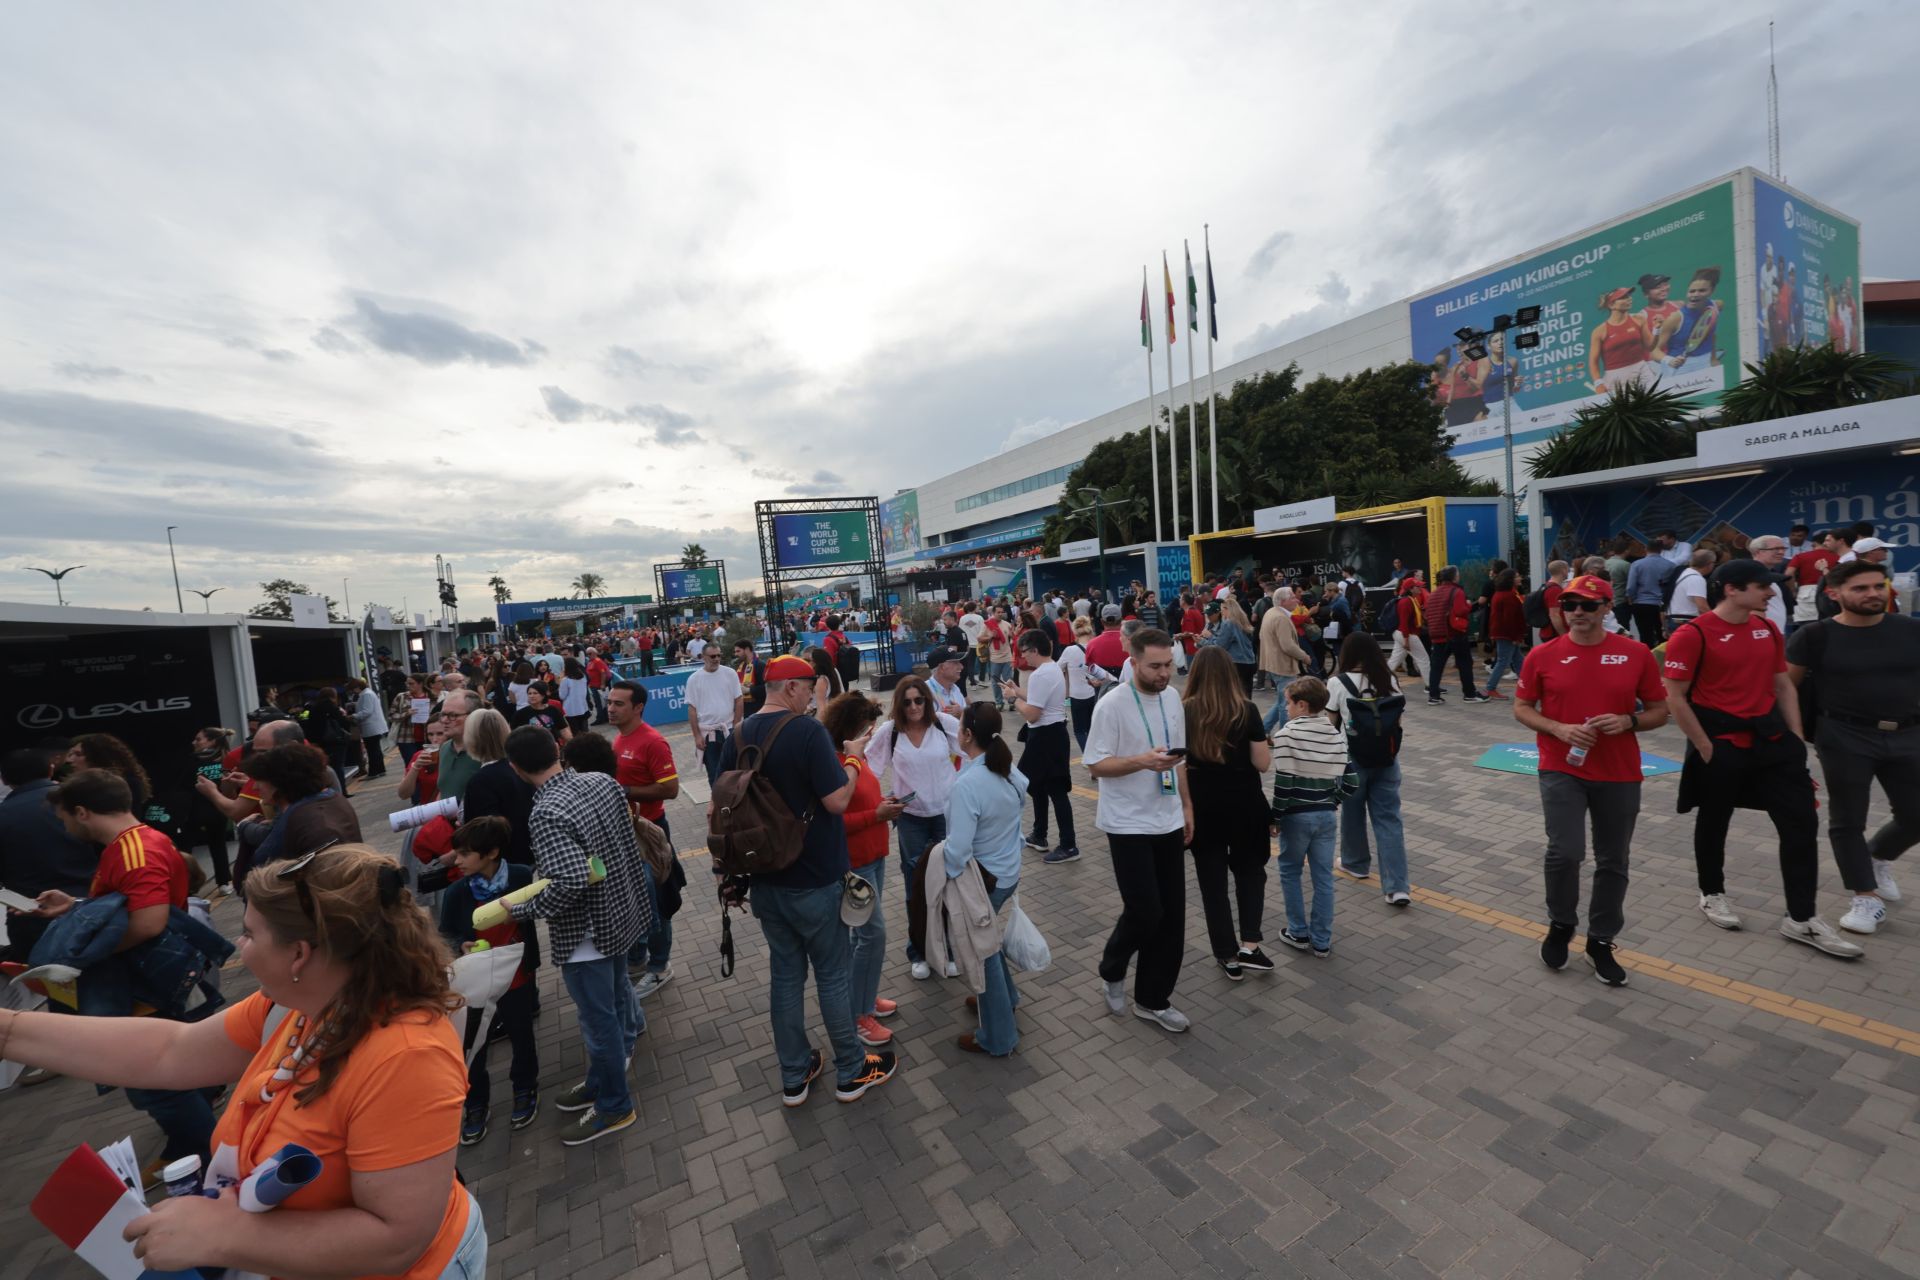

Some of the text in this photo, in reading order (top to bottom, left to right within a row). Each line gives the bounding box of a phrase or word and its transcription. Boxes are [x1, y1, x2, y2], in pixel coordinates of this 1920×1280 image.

[1819, 223, 1837, 241] CUP
[1435, 292, 1479, 317] BILLIE
[1480, 276, 1523, 302] JEAN
[1526, 259, 1569, 287] KING
[1571, 244, 1611, 269] CUP
[1643, 211, 1705, 241] GAINBRIDGE
[1540, 299, 1568, 318] HE
[1559, 326, 1583, 344] OF
[1522, 343, 1585, 370] TENNIS
[1744, 421, 1860, 446] SABOR A MÁLAGA
[1790, 480, 1852, 498] sabor
[1790, 500, 1806, 514] a
[814, 521, 831, 530] THE
[809, 529, 838, 539] WORLD
[810, 538, 839, 547] CUP OF
[811, 546, 840, 555] TENNIS
[1752, 629, 1771, 640] ESP
[83, 656, 116, 665] WORLD
[910, 651, 929, 662] THE
[1600, 654, 1628, 665] ESP
[648, 686, 675, 700] THE
[67, 696, 192, 719] LEXUS
